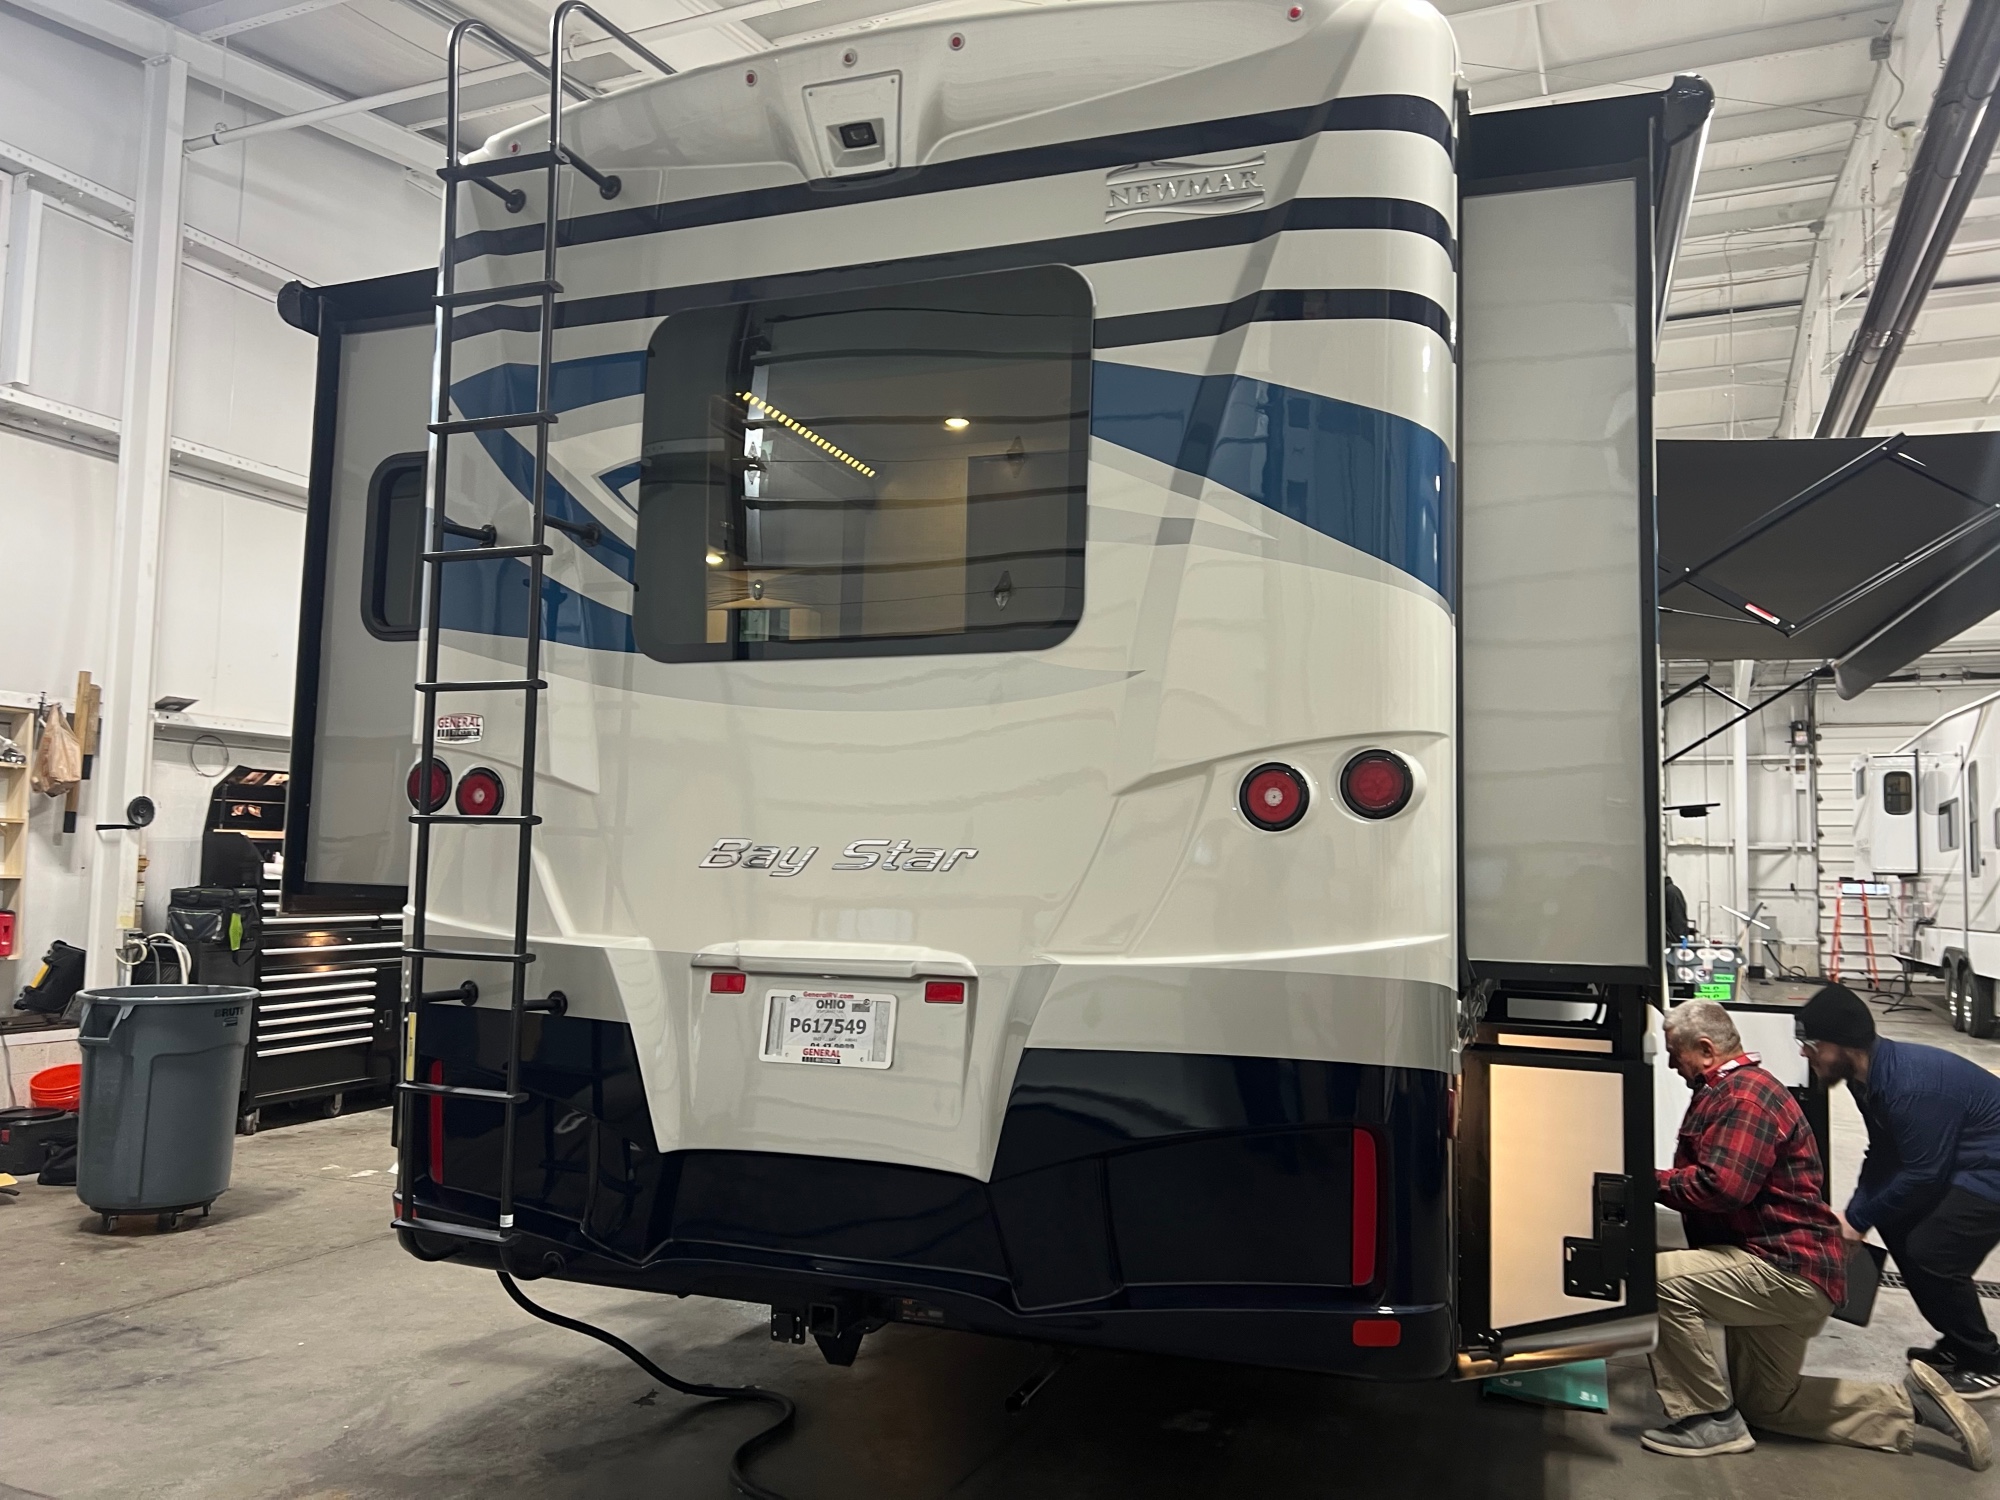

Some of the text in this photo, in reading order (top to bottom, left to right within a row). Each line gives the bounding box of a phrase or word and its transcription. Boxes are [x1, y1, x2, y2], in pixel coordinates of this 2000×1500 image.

[1108, 171, 1263, 207] NEWMAR
[437, 716, 481, 728] GENERAL
[698, 838, 979, 877] Bay Star
[803, 991, 854, 1000] GeneralRV.com
[816, 999, 846, 1010] OHIO
[789, 1017, 867, 1035] P617549
[802, 1047, 841, 1058] GENERAL
